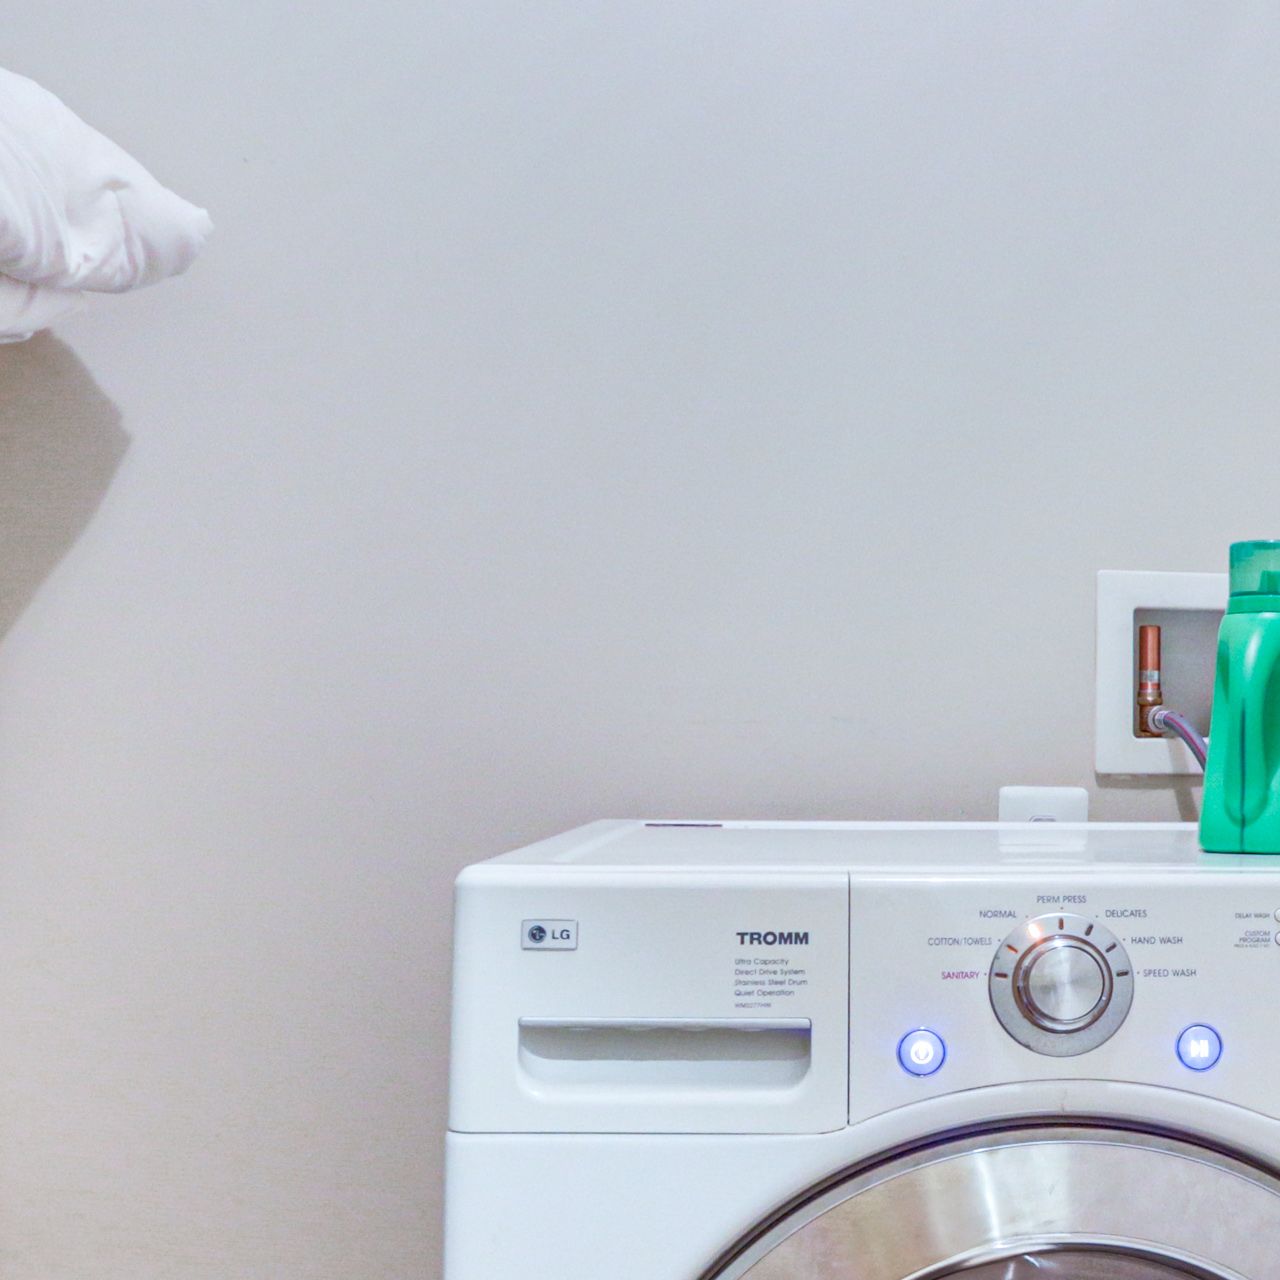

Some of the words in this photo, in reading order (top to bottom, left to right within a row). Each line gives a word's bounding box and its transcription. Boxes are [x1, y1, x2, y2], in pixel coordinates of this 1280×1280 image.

[1036, 895, 1061, 904] PERM
[1062, 895, 1087, 904] PRESS
[979, 910, 1017, 919] NORMAL
[1105, 909, 1147, 918] DELICATES
[551, 929, 571, 940] LG
[736, 931, 809, 945] TROMM
[927, 937, 992, 946] COTTON/TOWELS
[1131, 936, 1156, 945] HAND
[1159, 936, 1183, 944] WASH
[753, 958, 789, 966] Capacity
[735, 968, 757, 976] Direct
[758, 968, 778, 976] Drive
[941, 970, 979, 980] SANITARY
[1143, 969, 1169, 978] SPEED
[1172, 968, 1197, 977] WASH
[756, 989, 795, 997] Operation
